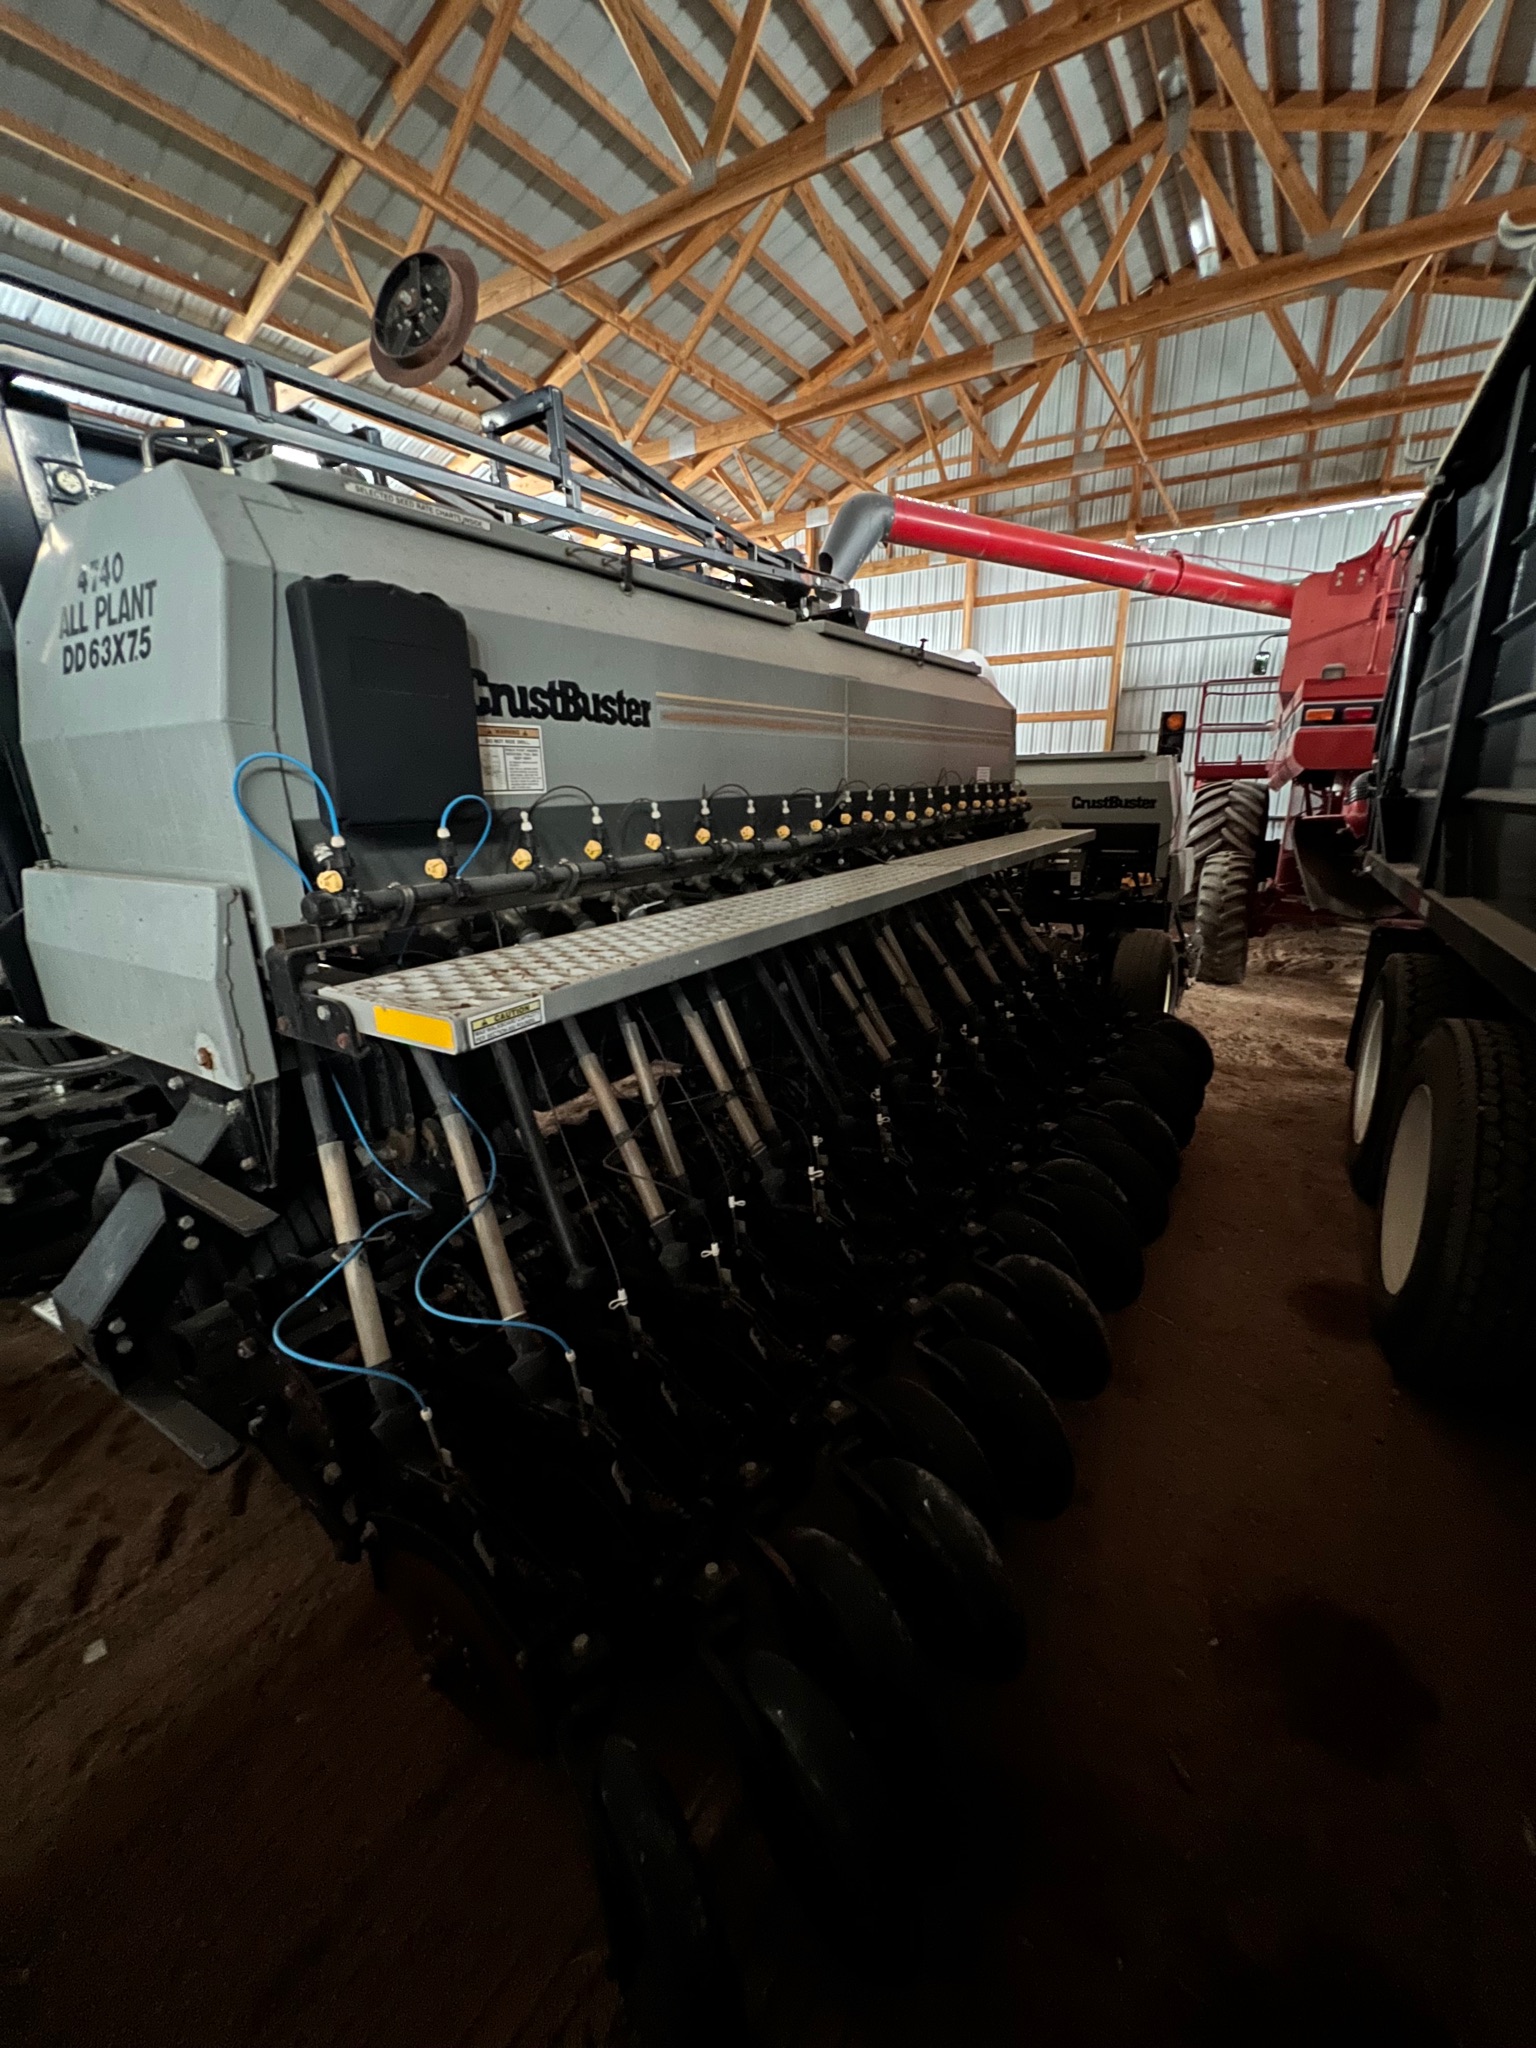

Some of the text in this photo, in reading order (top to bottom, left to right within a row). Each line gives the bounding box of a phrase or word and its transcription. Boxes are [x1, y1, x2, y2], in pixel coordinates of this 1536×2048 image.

[355, 485, 395, 504] SELECTED
[396, 496, 415, 508] SEED
[416, 502, 435, 514] RATE
[435, 507, 462, 522] CHARTS
[77, 552, 124, 594] 4740
[59, 579, 157, 639] ALL PLANT
[1072, 796, 1156, 809] CrustBuster
[494, 1006, 529, 1021] CAUTION
